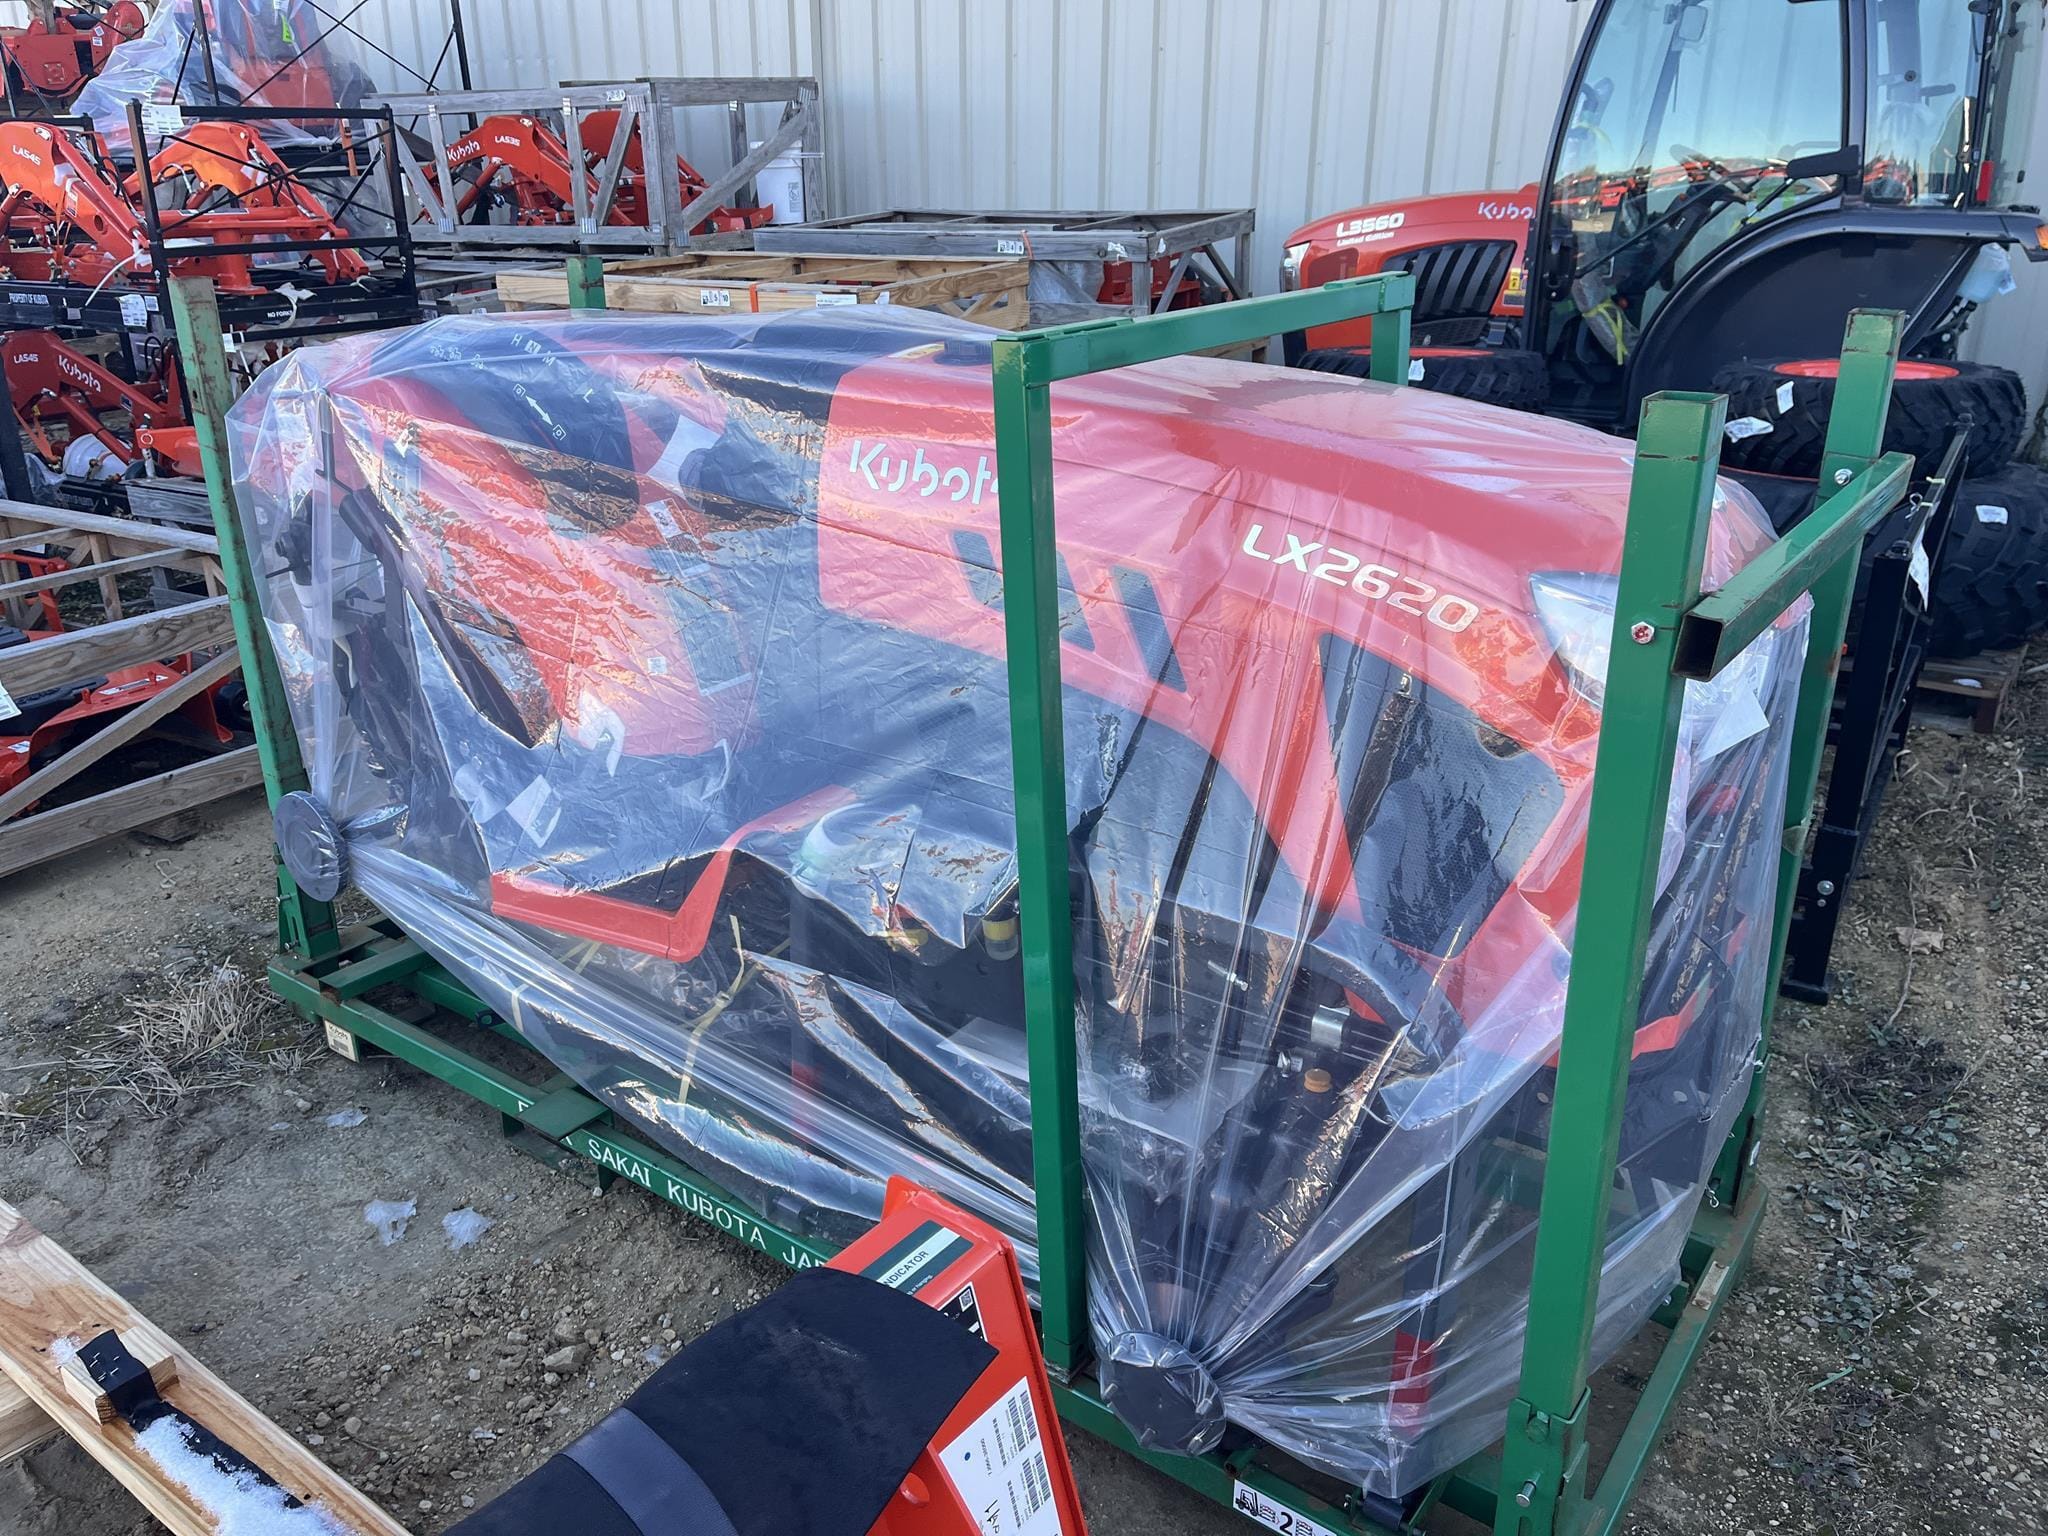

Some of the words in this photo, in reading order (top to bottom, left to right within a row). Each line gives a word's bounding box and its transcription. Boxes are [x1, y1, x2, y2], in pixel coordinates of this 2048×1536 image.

[12, 144, 42, 167] LA545
[446, 140, 481, 161] Kubota
[1478, 201, 1536, 219] Kubo
[1336, 212, 1405, 238] L3560
[1336, 236, 1364, 248] Limited
[1365, 232, 1395, 242] Edition
[511, 334, 523, 347] H
[13, 353, 39, 364] LA545
[58, 354, 101, 393] Kubota
[849, 439, 999, 505] Kubot
[1242, 523, 1481, 633] LX2620
[588, 1138, 651, 1188] SAKAI
[666, 1179, 767, 1250] KUBOTA
[1280, 1511, 1293, 1536] 2
